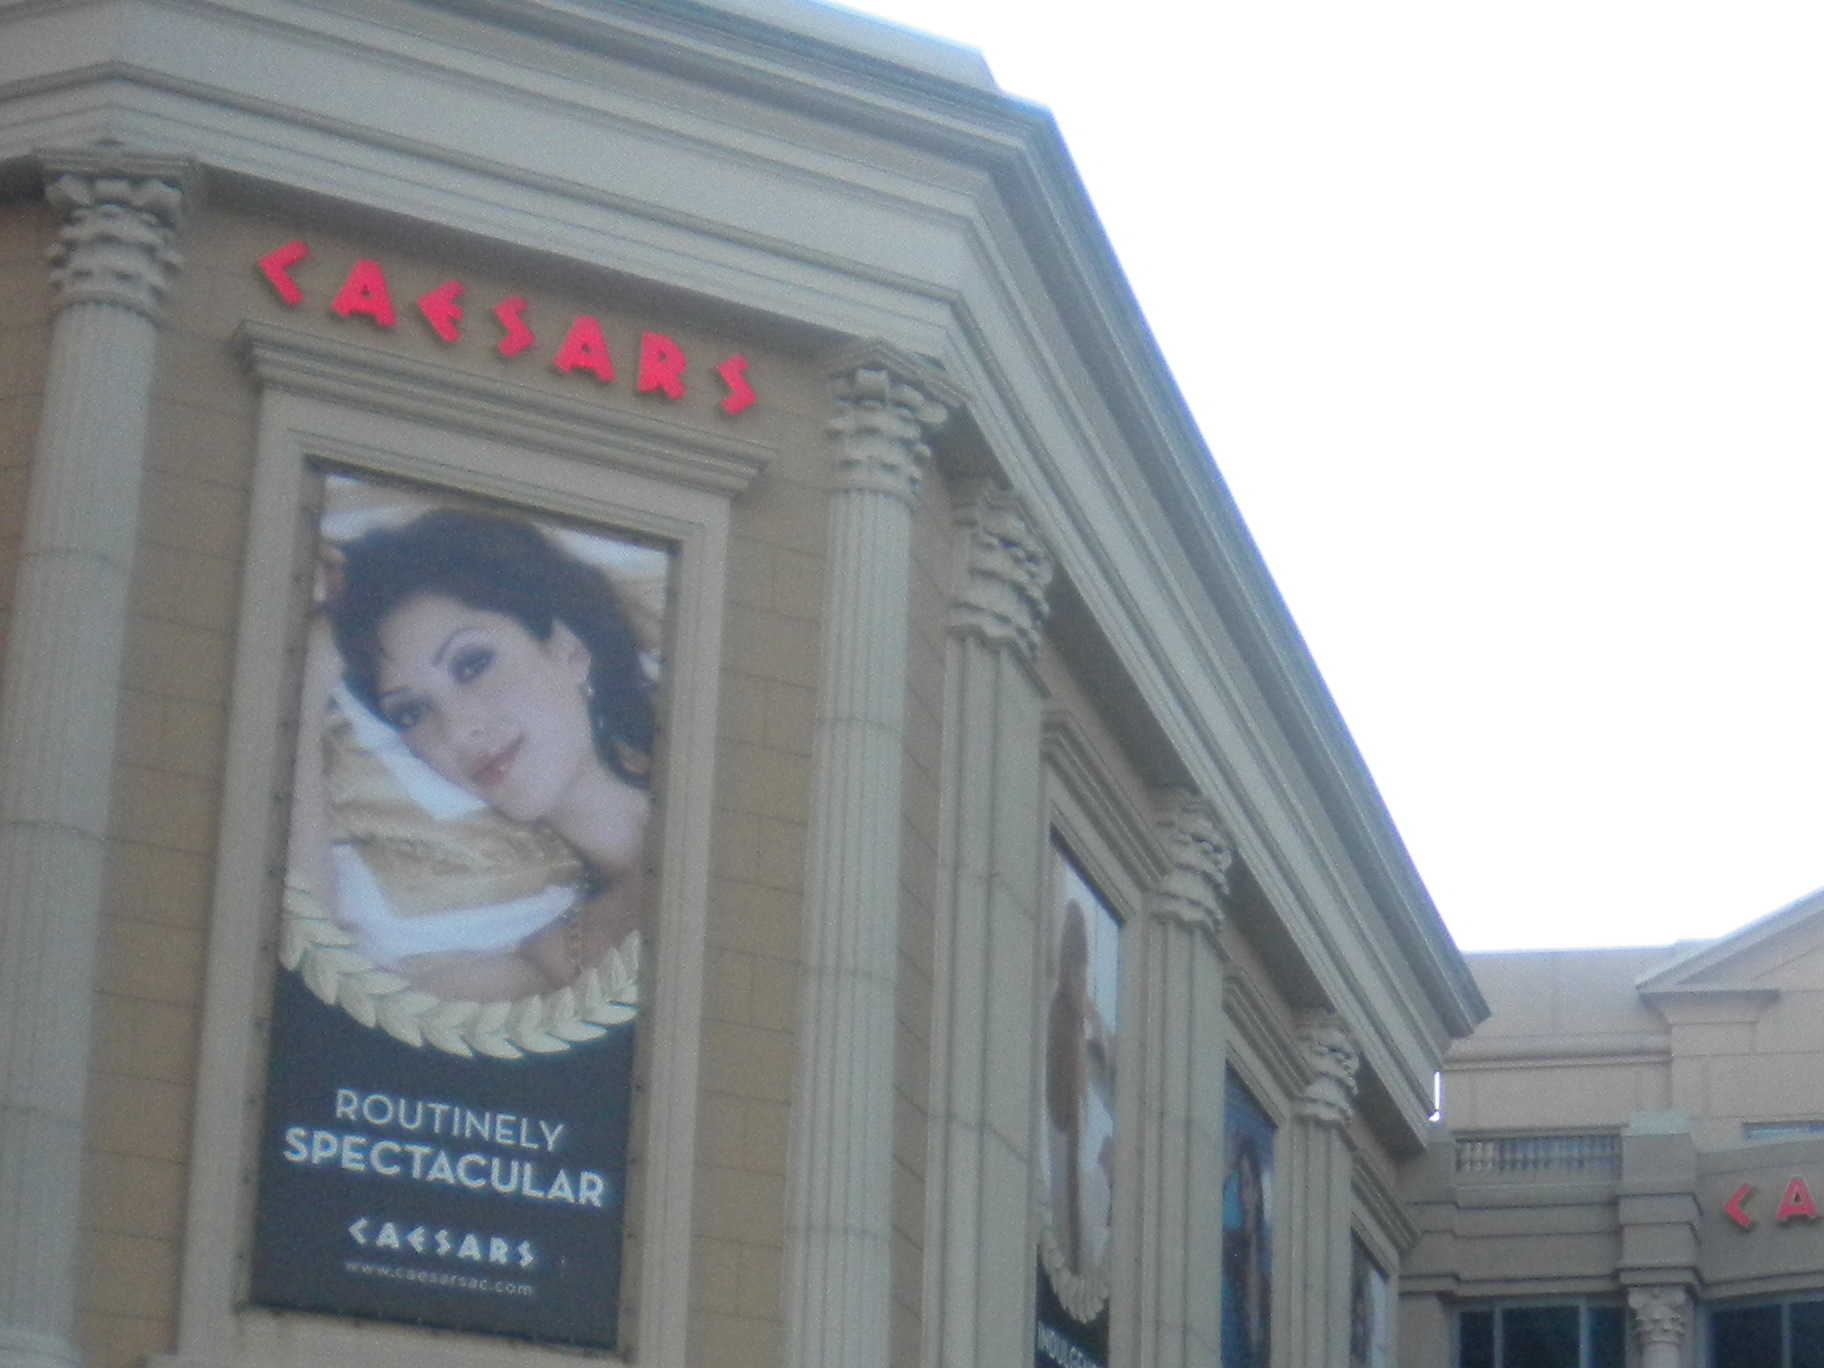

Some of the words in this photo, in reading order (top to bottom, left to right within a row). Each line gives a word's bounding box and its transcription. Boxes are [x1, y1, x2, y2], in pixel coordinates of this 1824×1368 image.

[258, 240, 758, 416] CAESARS
[335, 1088, 565, 1152] ROUTINELY
[283, 1126, 607, 1208] SPECTACULAR
[347, 1217, 537, 1269] CAESARS
[344, 1261, 536, 1297] www.caesarsac.com
